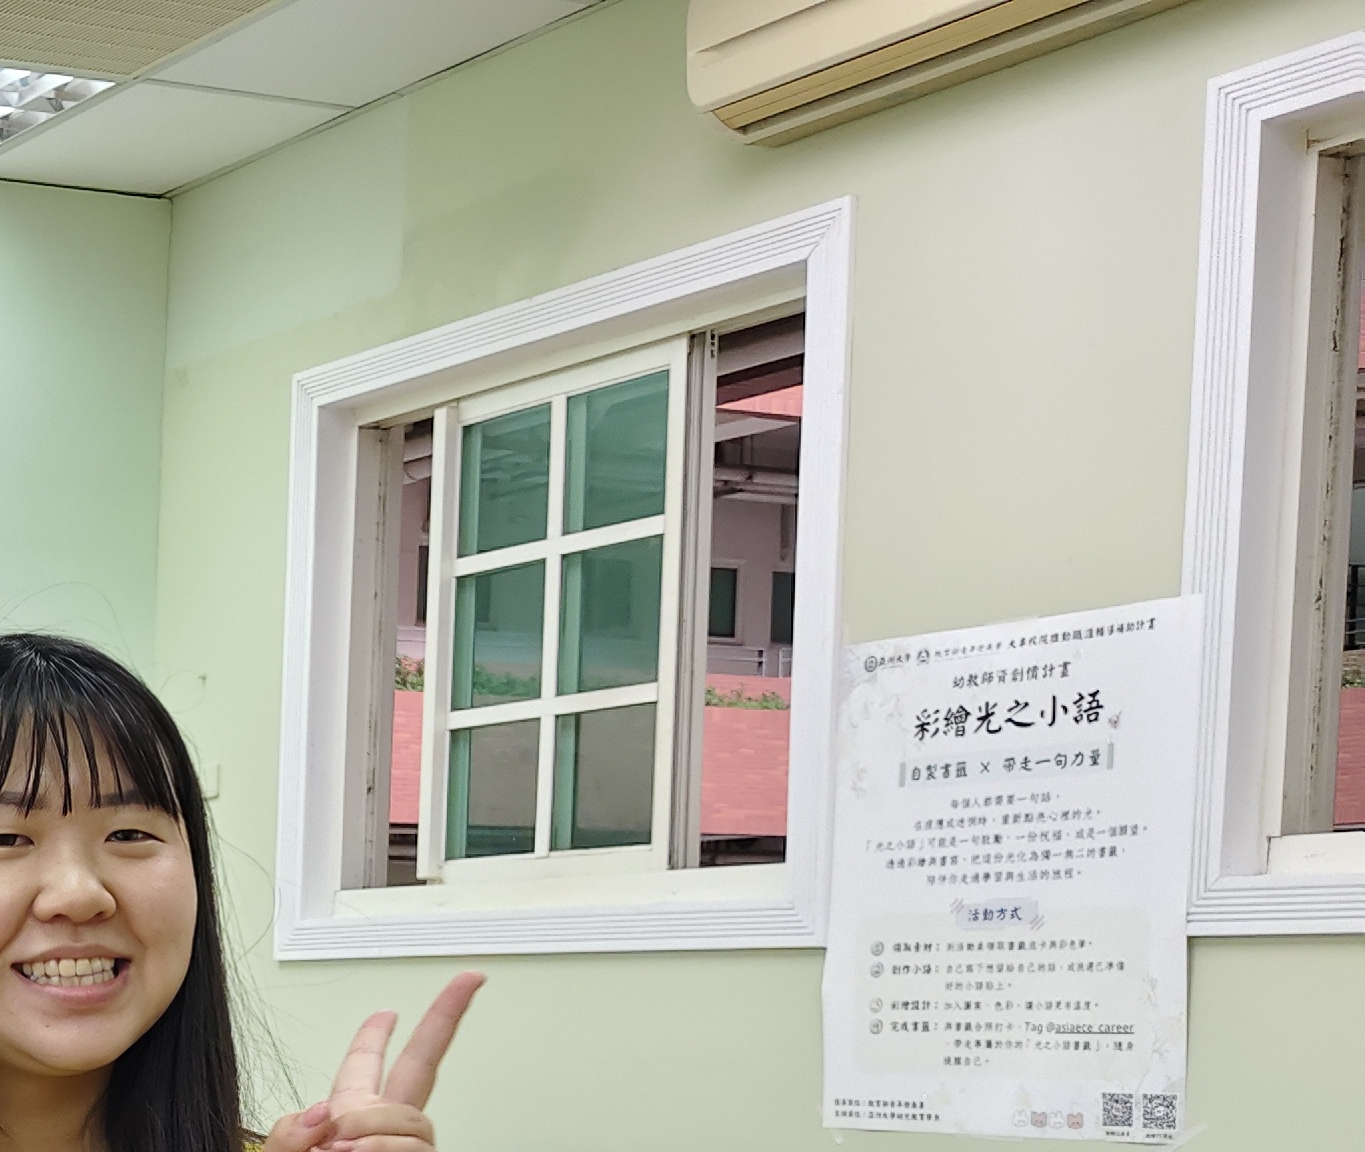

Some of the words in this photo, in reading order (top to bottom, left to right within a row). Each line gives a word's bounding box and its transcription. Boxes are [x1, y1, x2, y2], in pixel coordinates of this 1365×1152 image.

[914, 689, 1105, 741] 彩繪光之小語
[967, 906, 1023, 923] 活動方式
